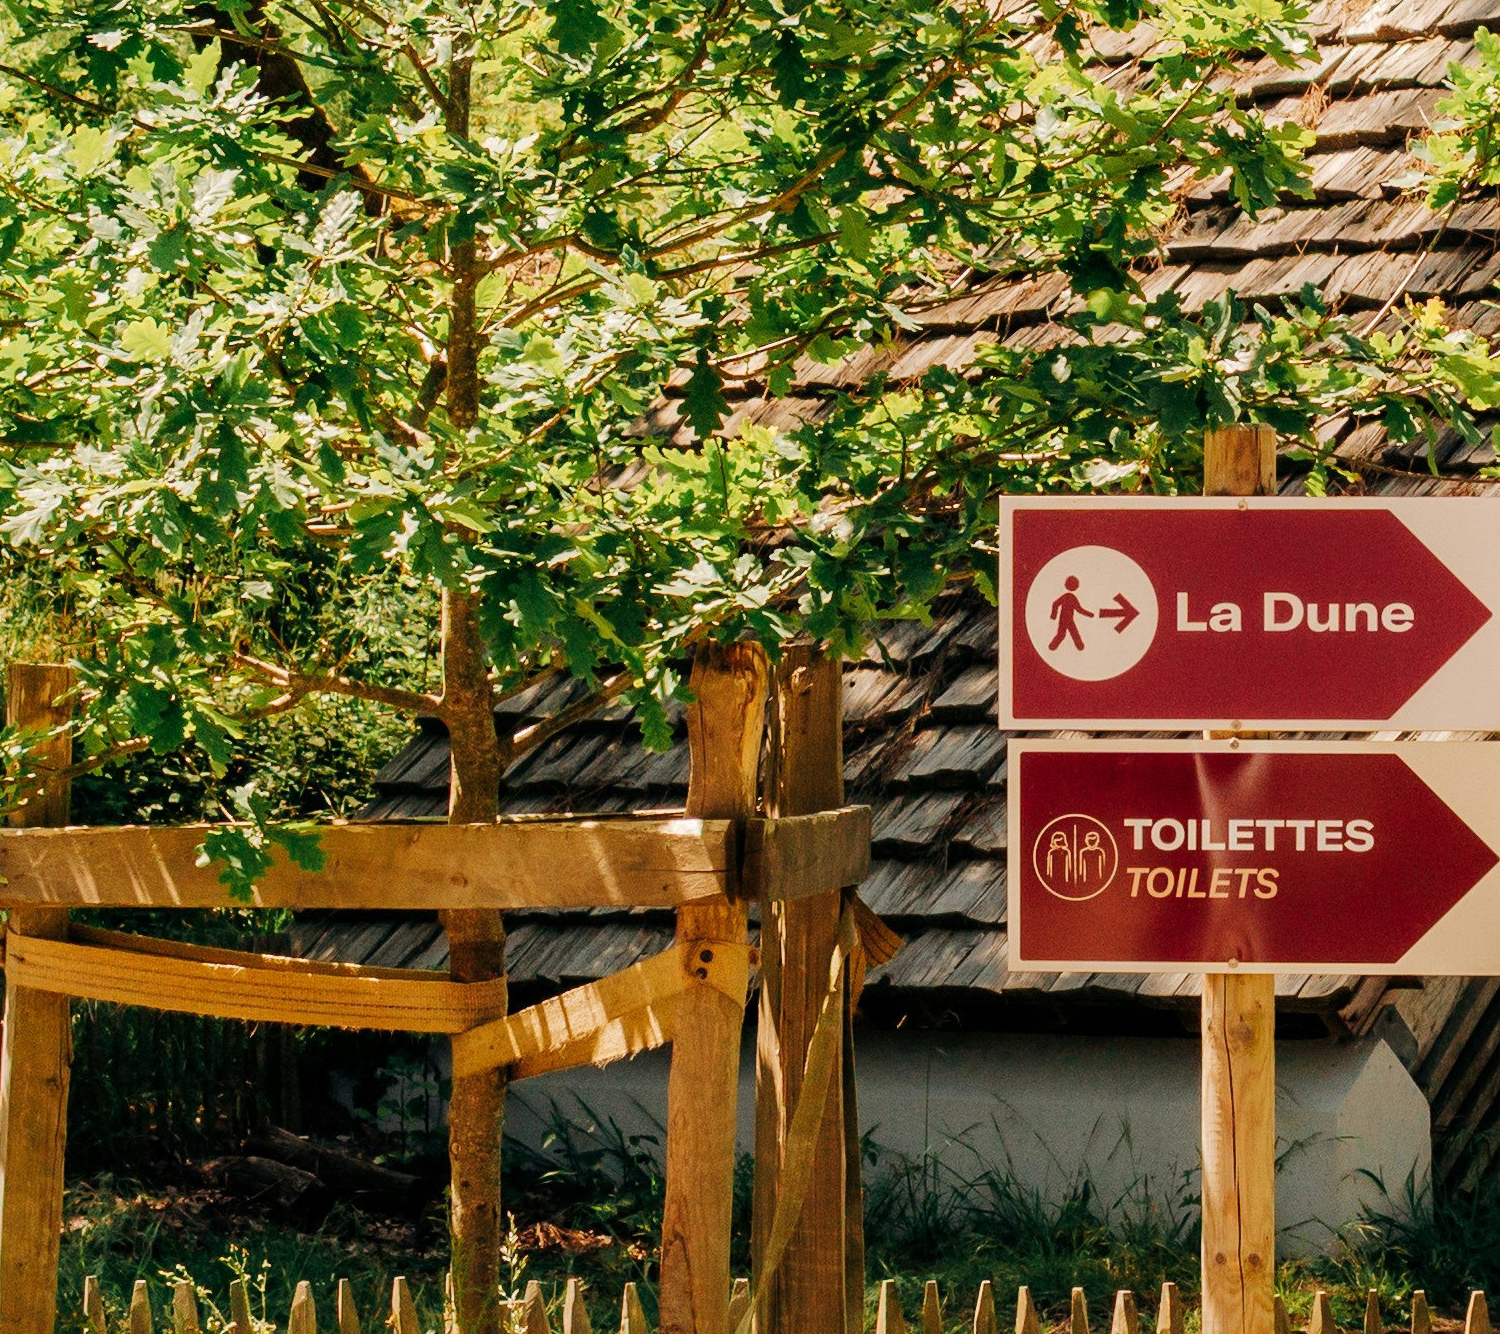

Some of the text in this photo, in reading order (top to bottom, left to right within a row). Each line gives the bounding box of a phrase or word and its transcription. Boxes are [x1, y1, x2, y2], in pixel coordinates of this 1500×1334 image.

[1176, 591, 1415, 633] La Dune
[1123, 818, 1375, 852] TOILETTES
[1126, 867, 1280, 899] TOILETS
